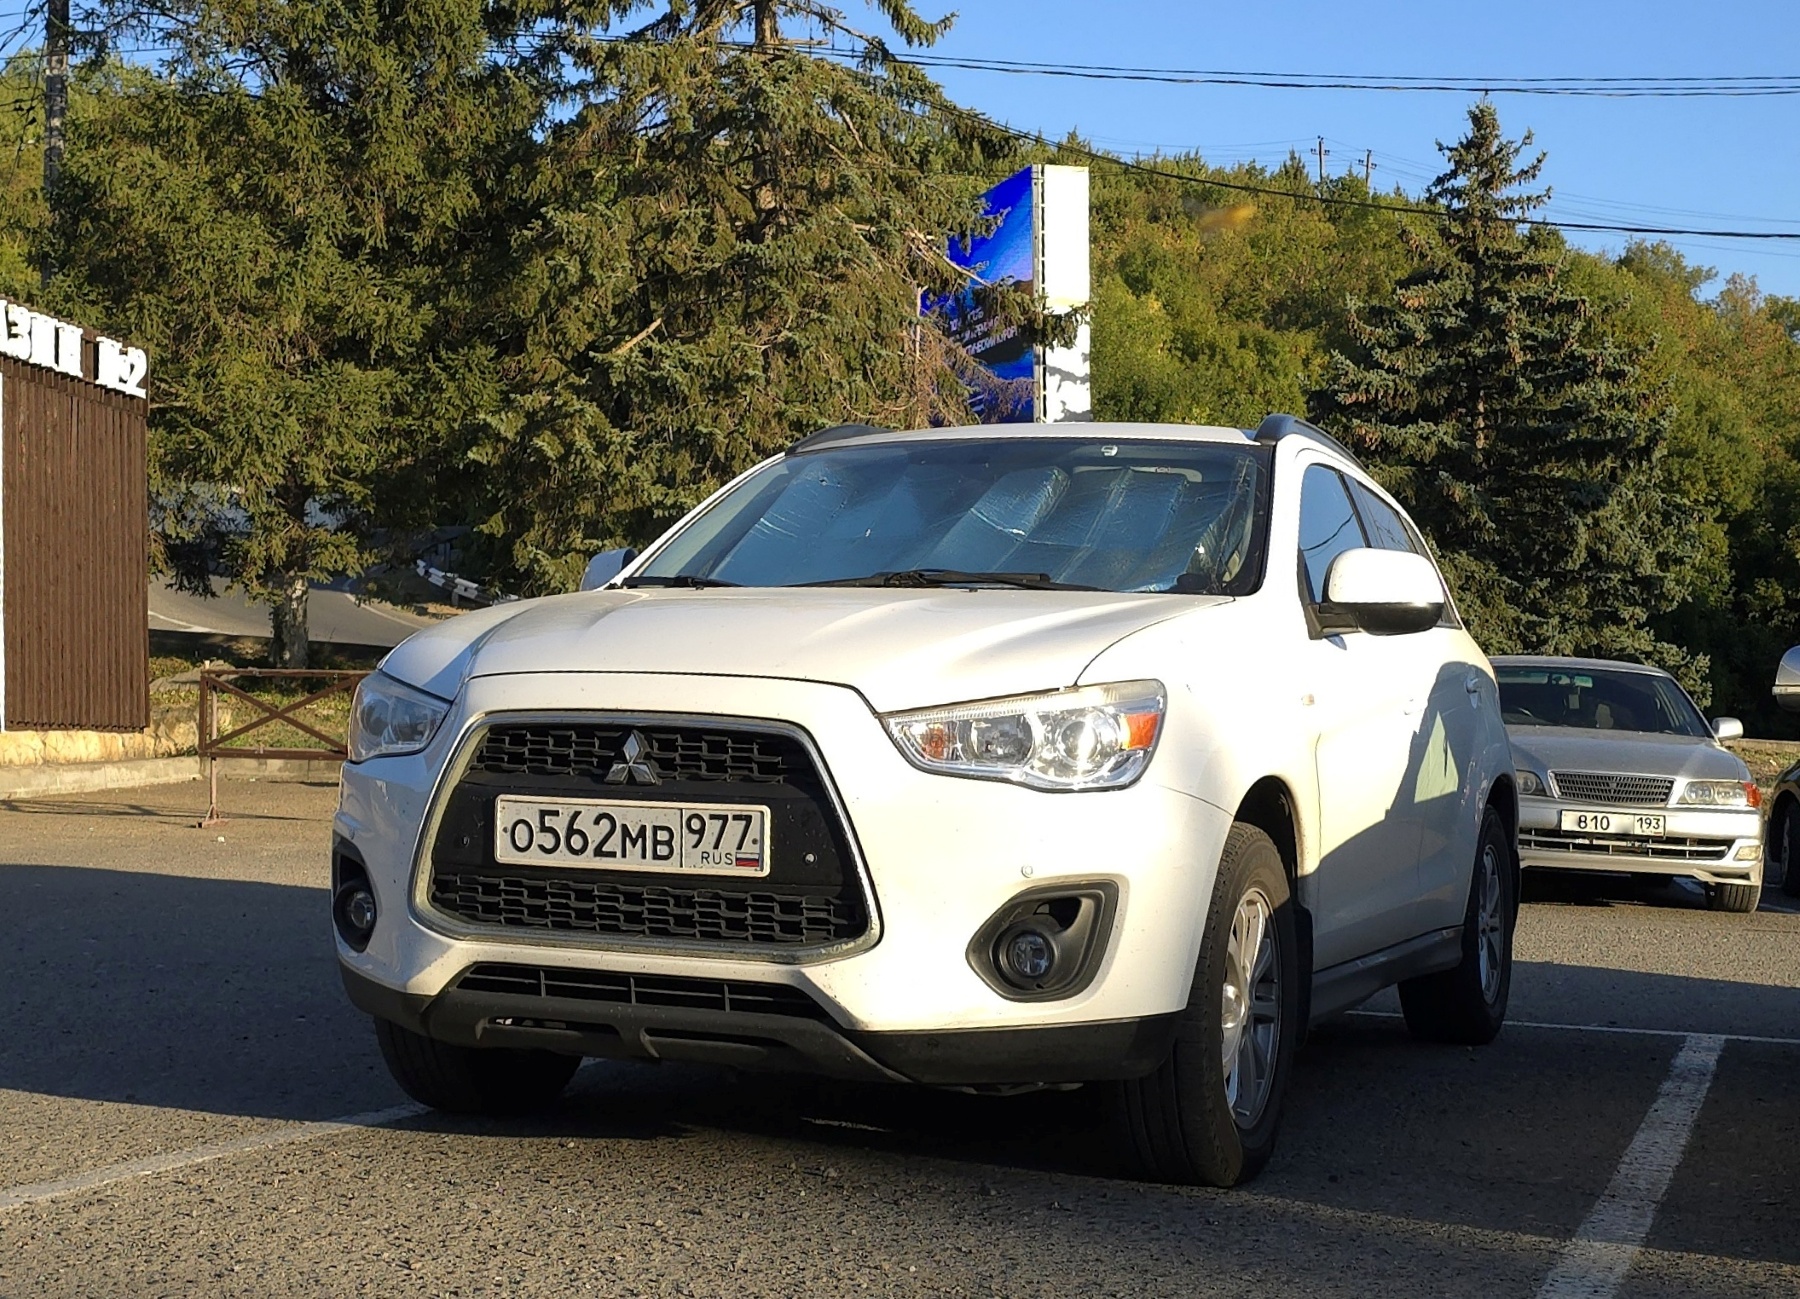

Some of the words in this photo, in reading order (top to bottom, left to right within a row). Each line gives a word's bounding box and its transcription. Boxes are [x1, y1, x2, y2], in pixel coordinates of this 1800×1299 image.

[1577, 814, 1610, 831] 810
[1636, 817, 1661, 830] 193
[686, 813, 753, 851] 977
[701, 851, 734, 865] RUS
